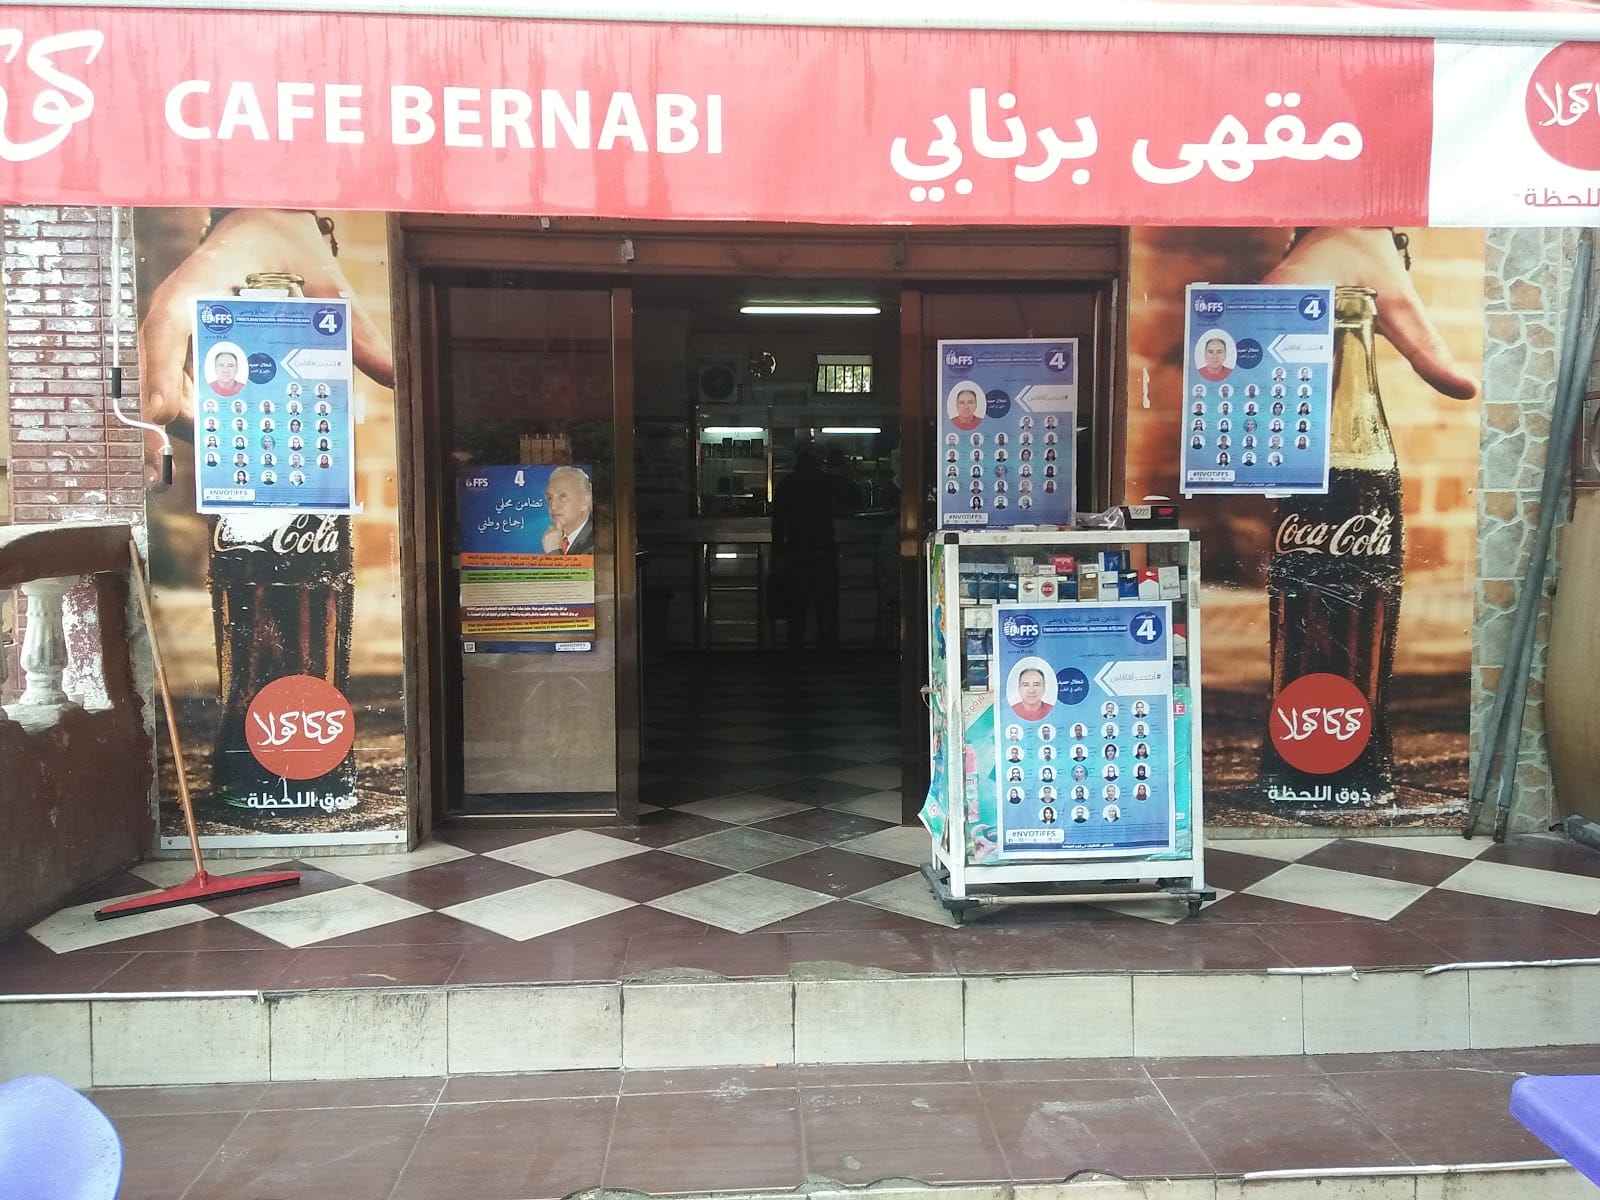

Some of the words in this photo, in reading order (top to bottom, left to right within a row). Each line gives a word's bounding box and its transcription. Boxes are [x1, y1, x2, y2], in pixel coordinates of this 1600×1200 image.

[164, 79, 364, 145] CAFE
[398, 84, 724, 155] BERNABI
[890, 87, 1100, 203] برنابي
[1131, 91, 1365, 185] مقهى
[1207, 301, 1224, 313] FFS
[1303, 299, 1322, 318] 4
[214, 313, 233, 325] FFS
[318, 313, 338, 333] 4
[958, 355, 974, 366] FFS
[1049, 351, 1067, 370] 4
[472, 478, 489, 488] FFS
[514, 470, 526, 487] 4
[495, 498, 513, 514] محلي
[515, 497, 543, 511] تضامن
[478, 516, 500, 533] وطني
[502, 516, 525, 533] إجماع
[1275, 512, 1395, 557] Coca-Cola
[1020, 624, 1039, 636] FFS
[1136, 618, 1157, 641] 4
[253, 711, 299, 747] كولا
[301, 710, 346, 745] كوكا
[1277, 707, 1322, 741] كولا
[1322, 707, 1365, 741] كوكا
[247, 791, 316, 810] اللحظة
[1267, 784, 1332, 804] اللحظة
[1335, 785, 1371, 804] ذوق
